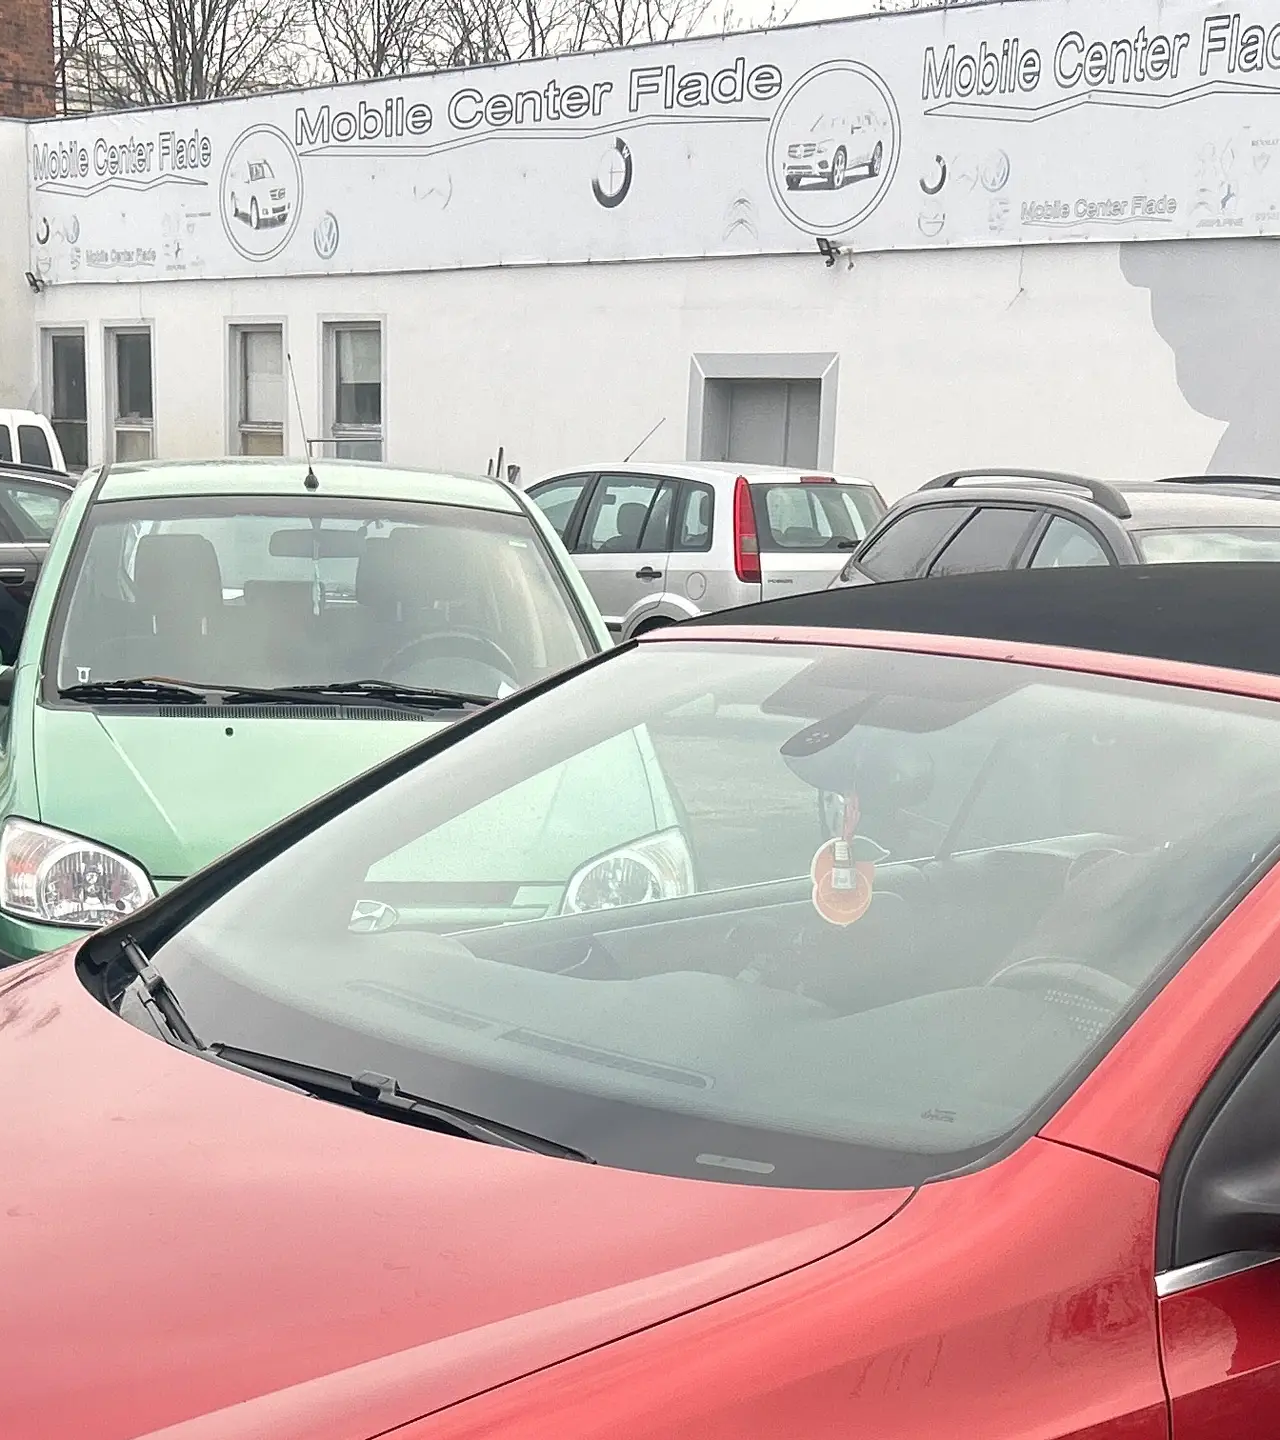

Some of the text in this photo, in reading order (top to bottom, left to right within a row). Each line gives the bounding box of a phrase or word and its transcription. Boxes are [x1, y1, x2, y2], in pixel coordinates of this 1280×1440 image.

[921, 38, 1042, 100] Mobile
[1053, 26, 1191, 89] Center
[294, 57, 783, 146] Mobile Center Flade
[33, 128, 212, 181] Mobile Center Flade
[1074, 198, 1129, 217] Center
